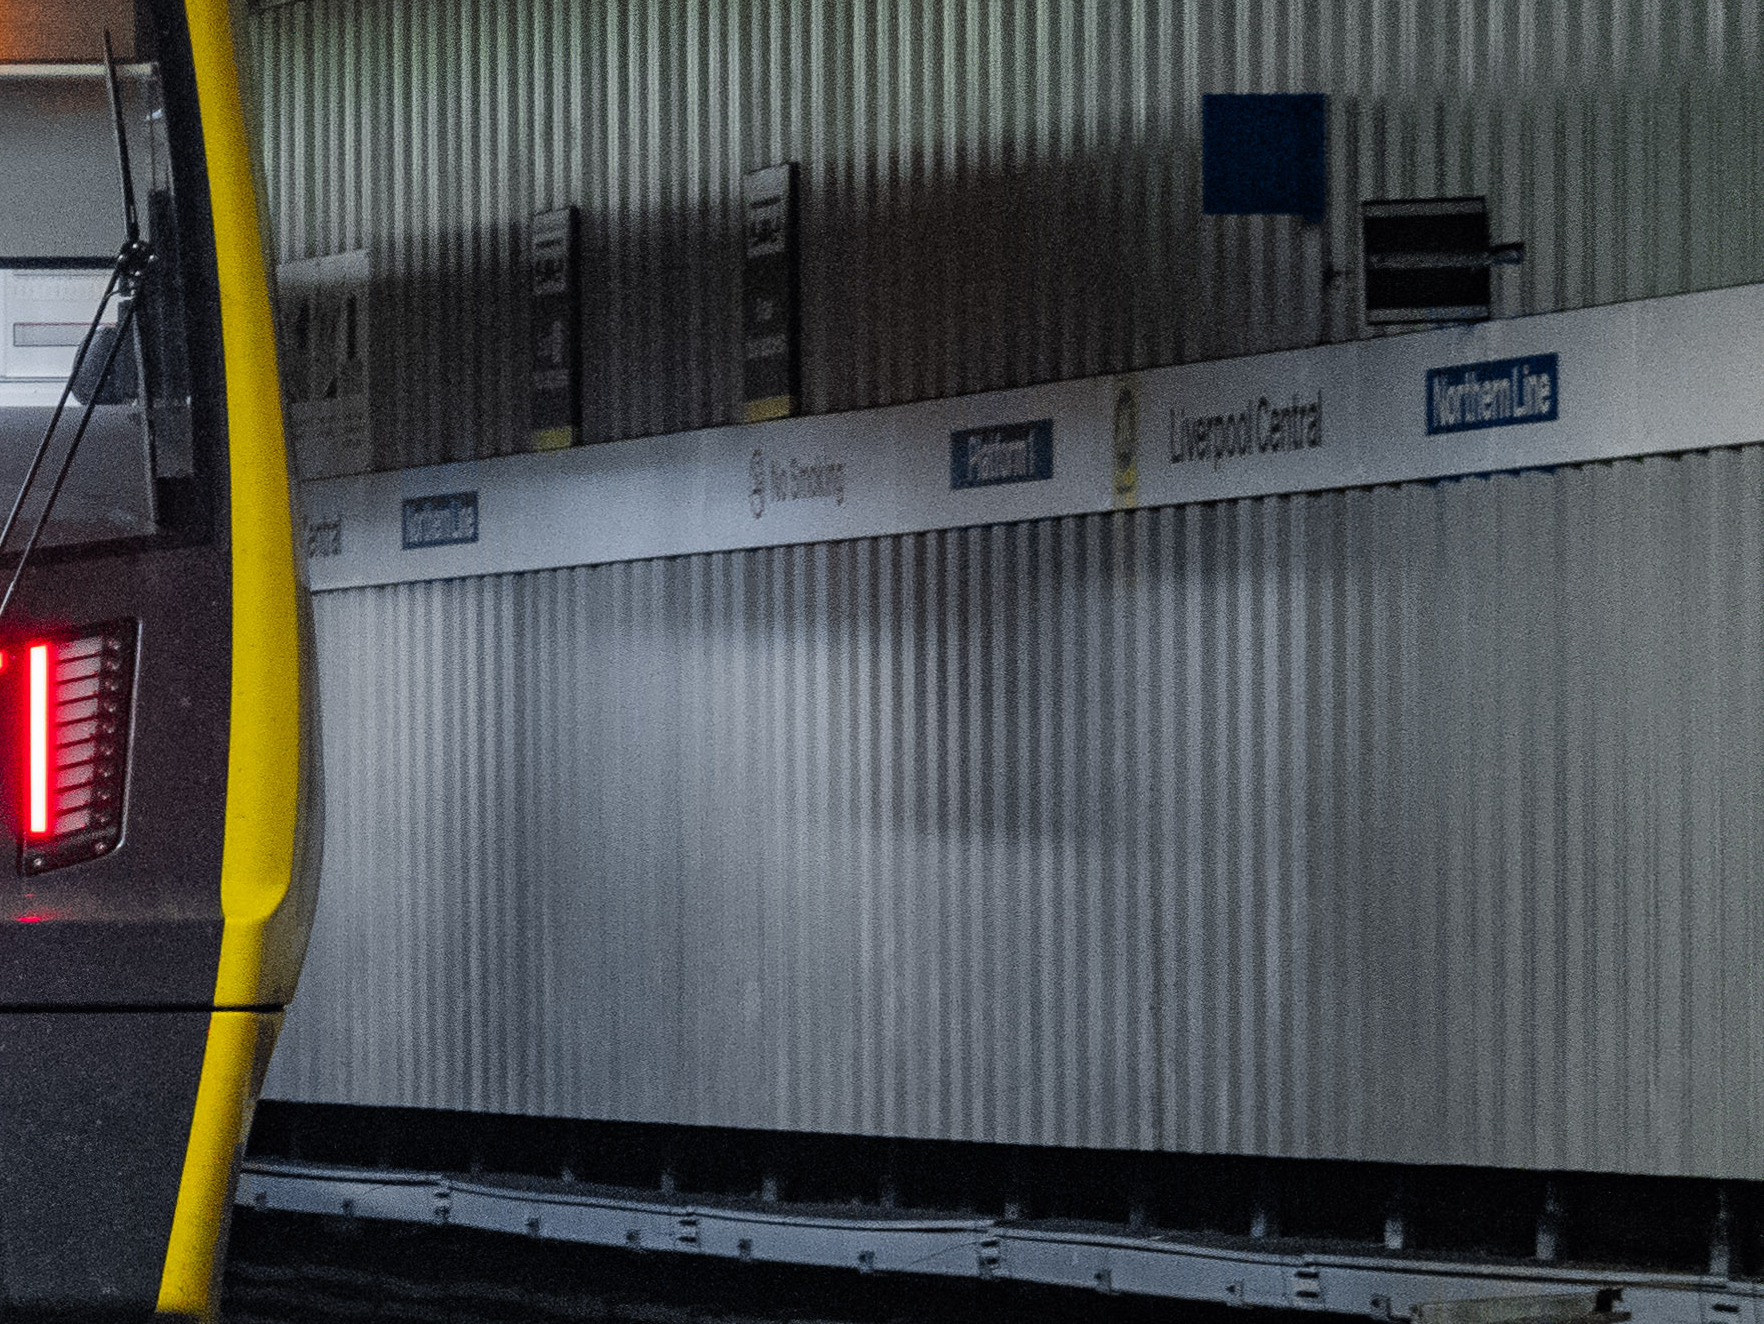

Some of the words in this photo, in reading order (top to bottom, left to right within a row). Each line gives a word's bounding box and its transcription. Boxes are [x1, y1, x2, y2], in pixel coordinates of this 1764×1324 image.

[1171, 399, 1255, 473] Liverpool
[1255, 387, 1324, 456] Central
[1432, 370, 1513, 429] Northern
[1513, 366, 1552, 418] Line
